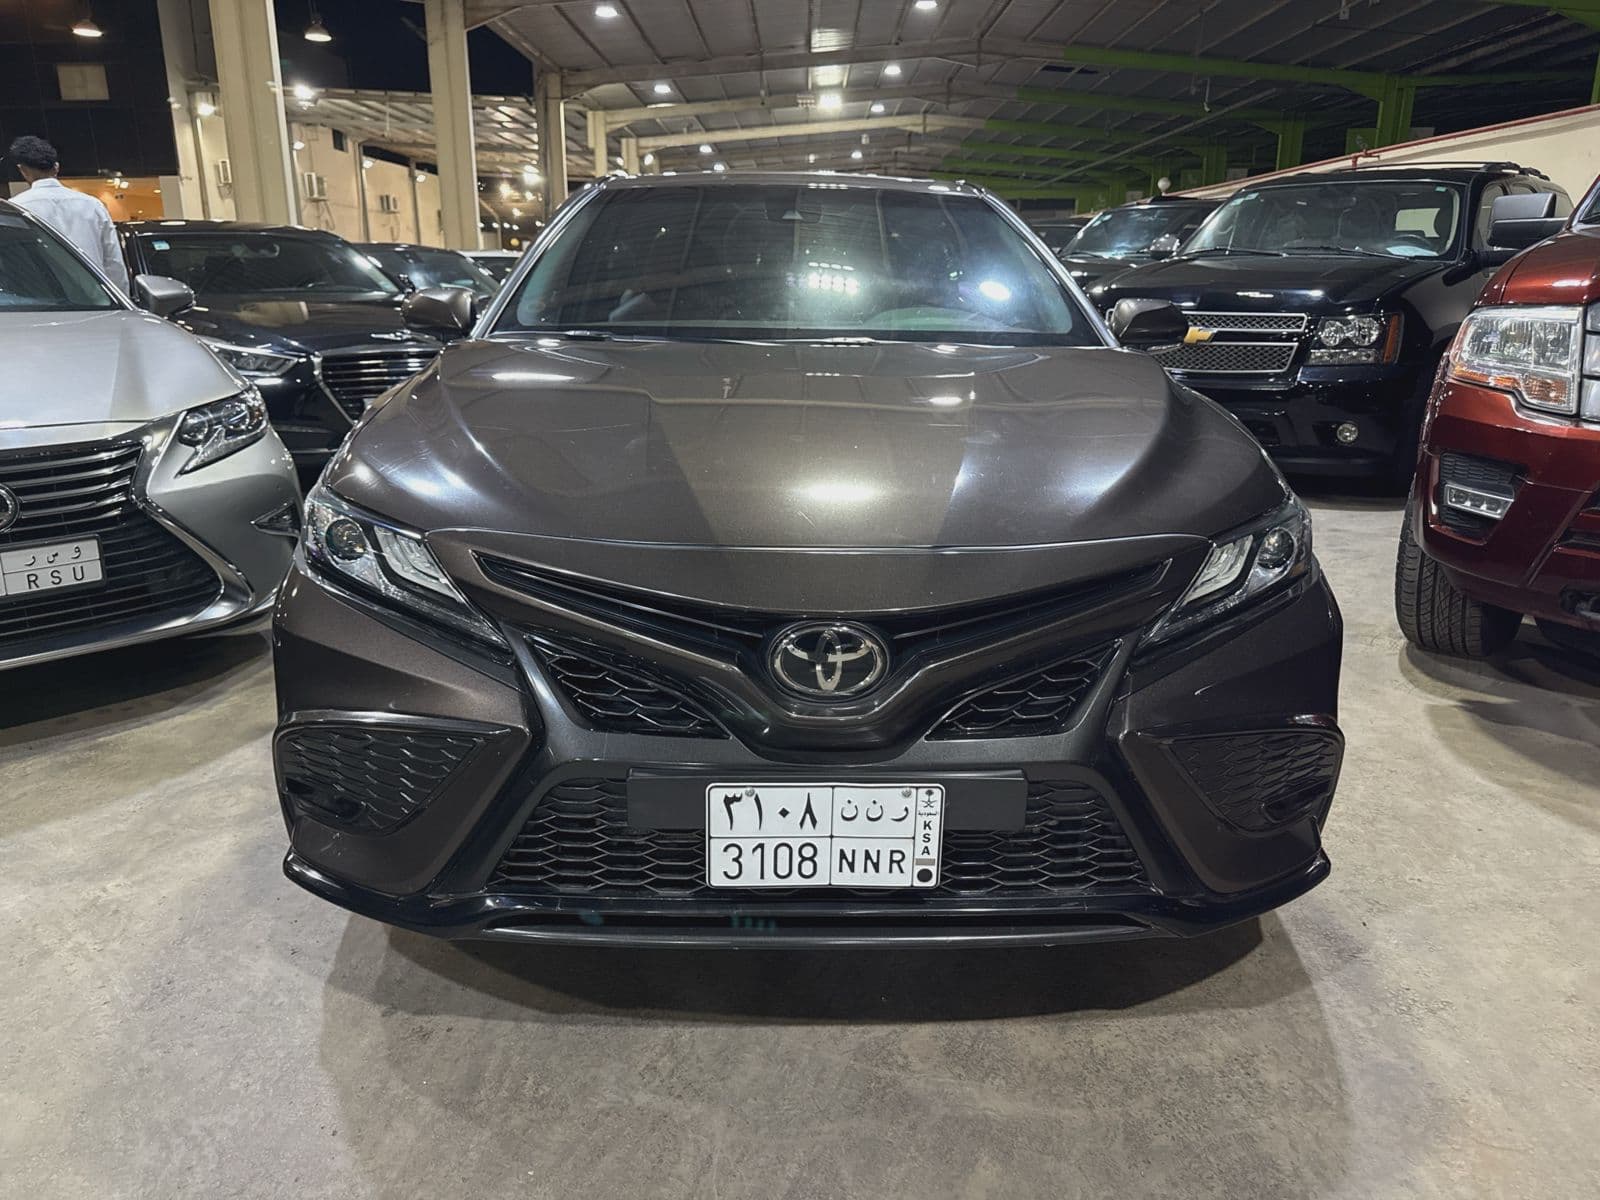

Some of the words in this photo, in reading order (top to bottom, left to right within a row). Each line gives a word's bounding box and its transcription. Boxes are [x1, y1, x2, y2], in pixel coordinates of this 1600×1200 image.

[26, 565, 85, 590] RSU
[723, 792, 818, 831] ٣١٠٨
[921, 820, 932, 856] KSA
[722, 842, 818, 880] 3108
[838, 848, 906, 874] NNR
